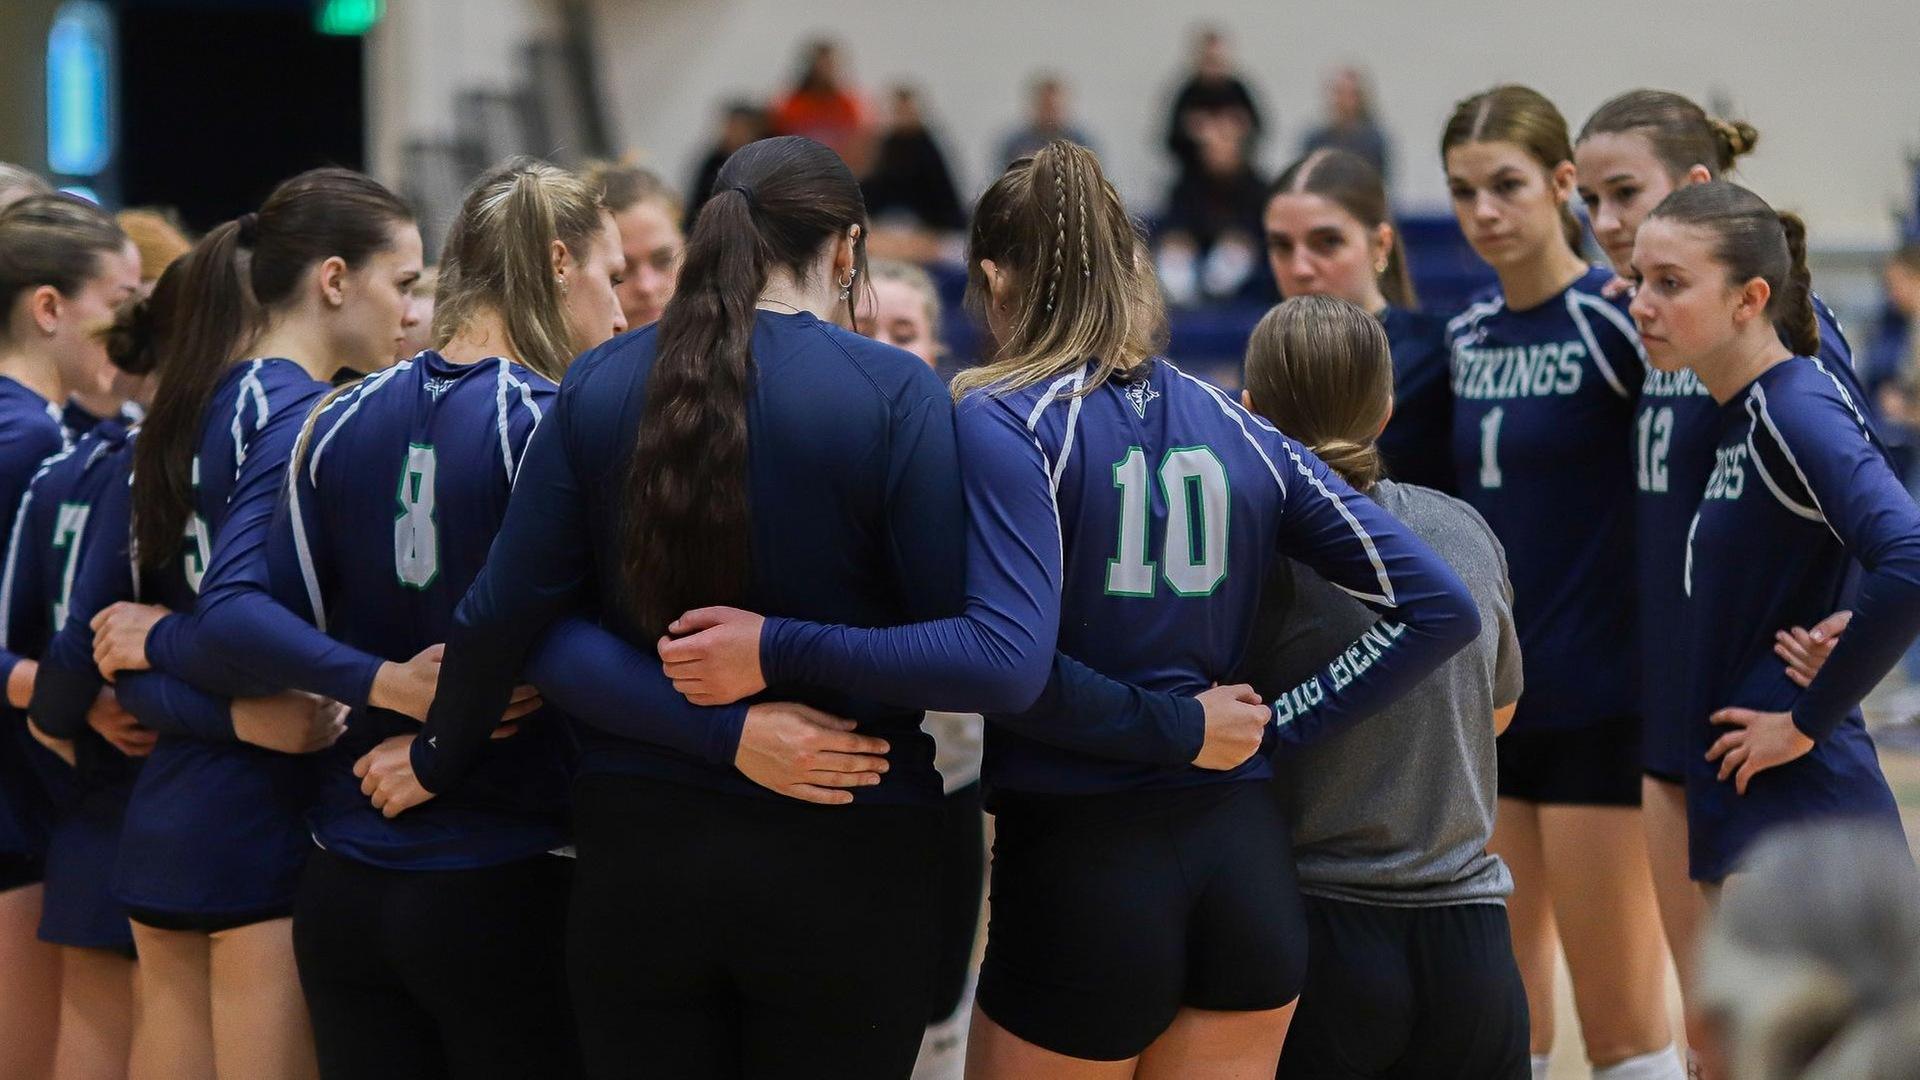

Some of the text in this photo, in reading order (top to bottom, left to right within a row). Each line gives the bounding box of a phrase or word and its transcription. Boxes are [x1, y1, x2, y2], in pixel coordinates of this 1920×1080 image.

[1454, 341, 1586, 399] VIKINGS
[1480, 406, 1504, 489] 1
[1638, 406, 1674, 492] 12
[394, 443, 439, 589] 8
[1104, 445, 1231, 598] 10
[53, 503, 90, 631] 7
[1275, 676, 1323, 726] BIG
